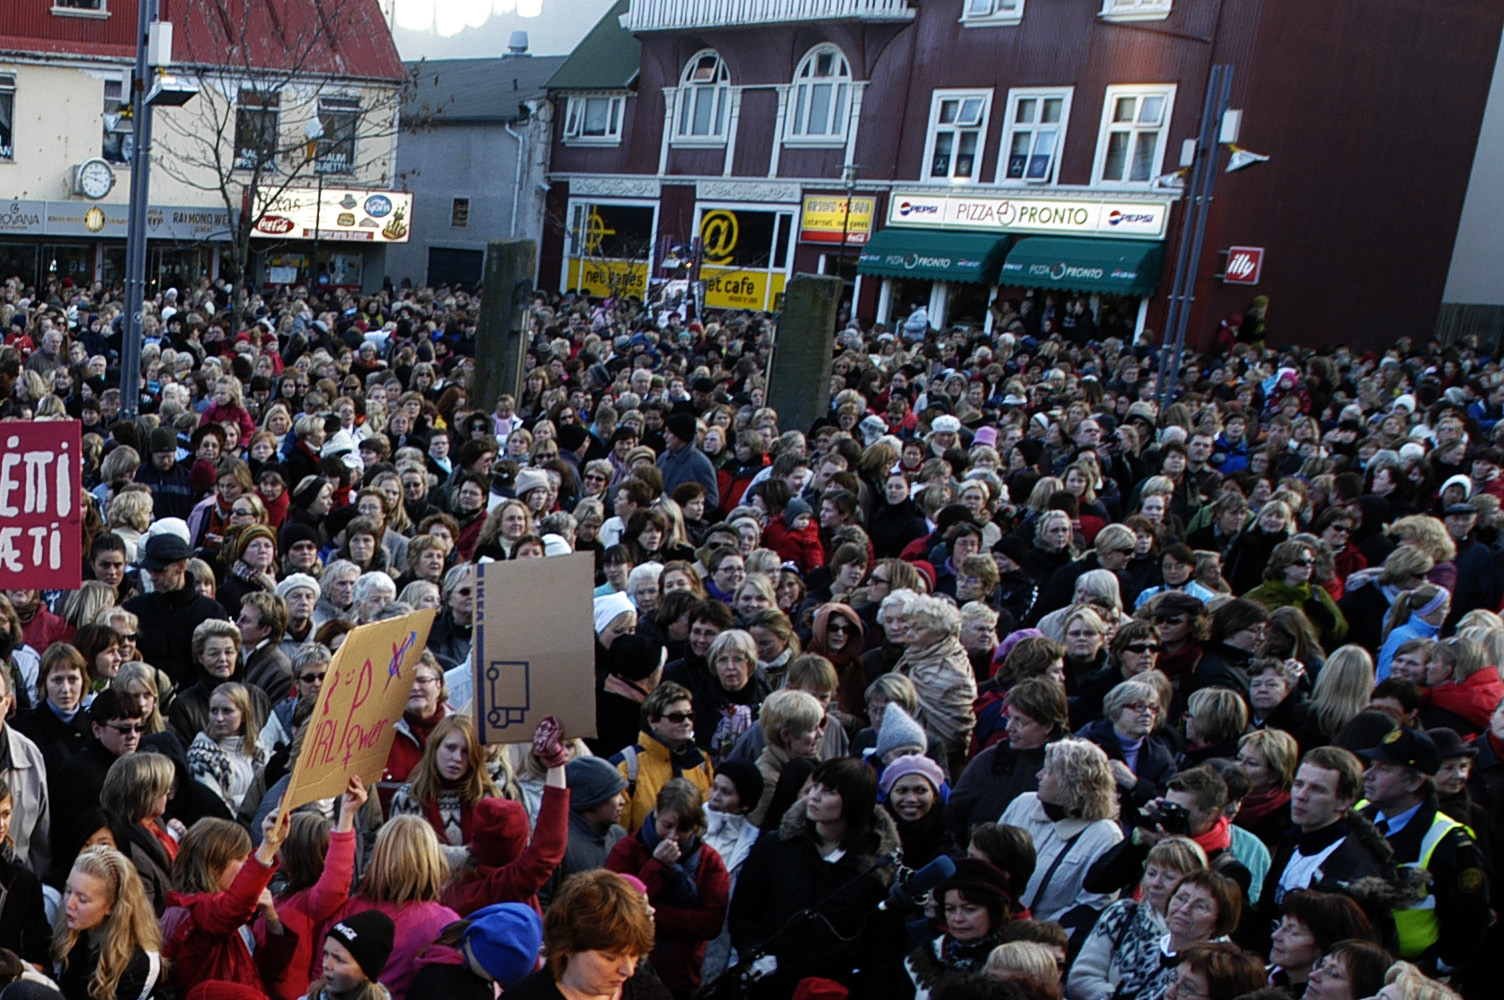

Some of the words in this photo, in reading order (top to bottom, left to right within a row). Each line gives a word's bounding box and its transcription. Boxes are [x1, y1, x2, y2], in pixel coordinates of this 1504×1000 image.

[909, 205, 939, 214] PEPSI
[956, 203, 994, 221] PIZZA
[1018, 206, 1089, 225] PRONTO
[173, 212, 213, 225] RAYMOND
[1118, 213, 1156, 223] PEPSI
[1065, 269, 1104, 279] PRONTO
[1228, 253, 1256, 279] illy
[724, 276, 755, 295] cafe
[476, 580, 485, 622] IKEA
